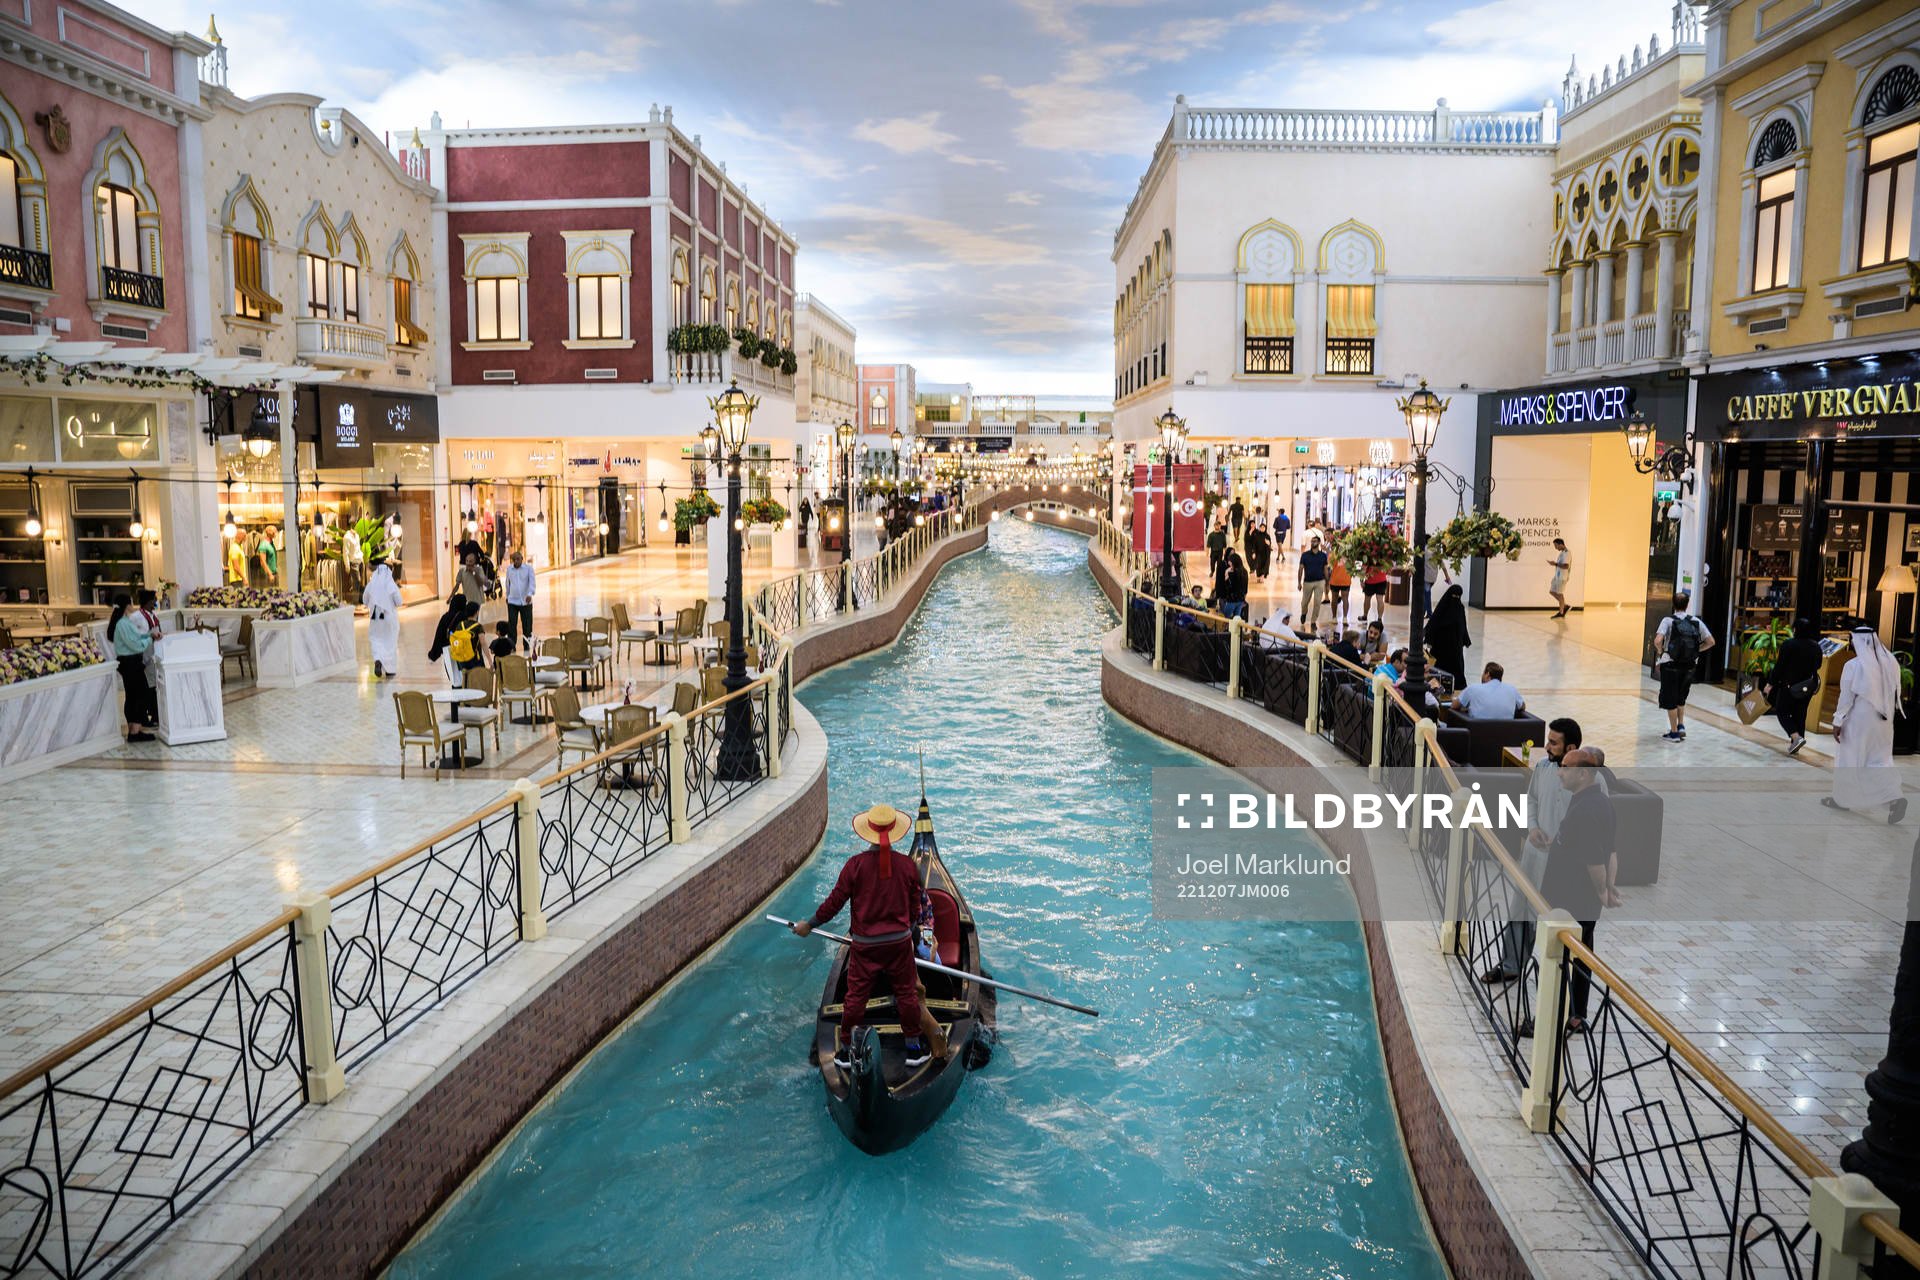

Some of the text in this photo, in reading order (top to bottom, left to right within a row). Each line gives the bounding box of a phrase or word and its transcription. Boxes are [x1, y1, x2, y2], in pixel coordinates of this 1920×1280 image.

[1500, 386, 1626, 426] MARKS&SPENCER
[1727, 392, 1799, 422] CAFFE'
[1517, 518, 1559, 526] MARKS &
